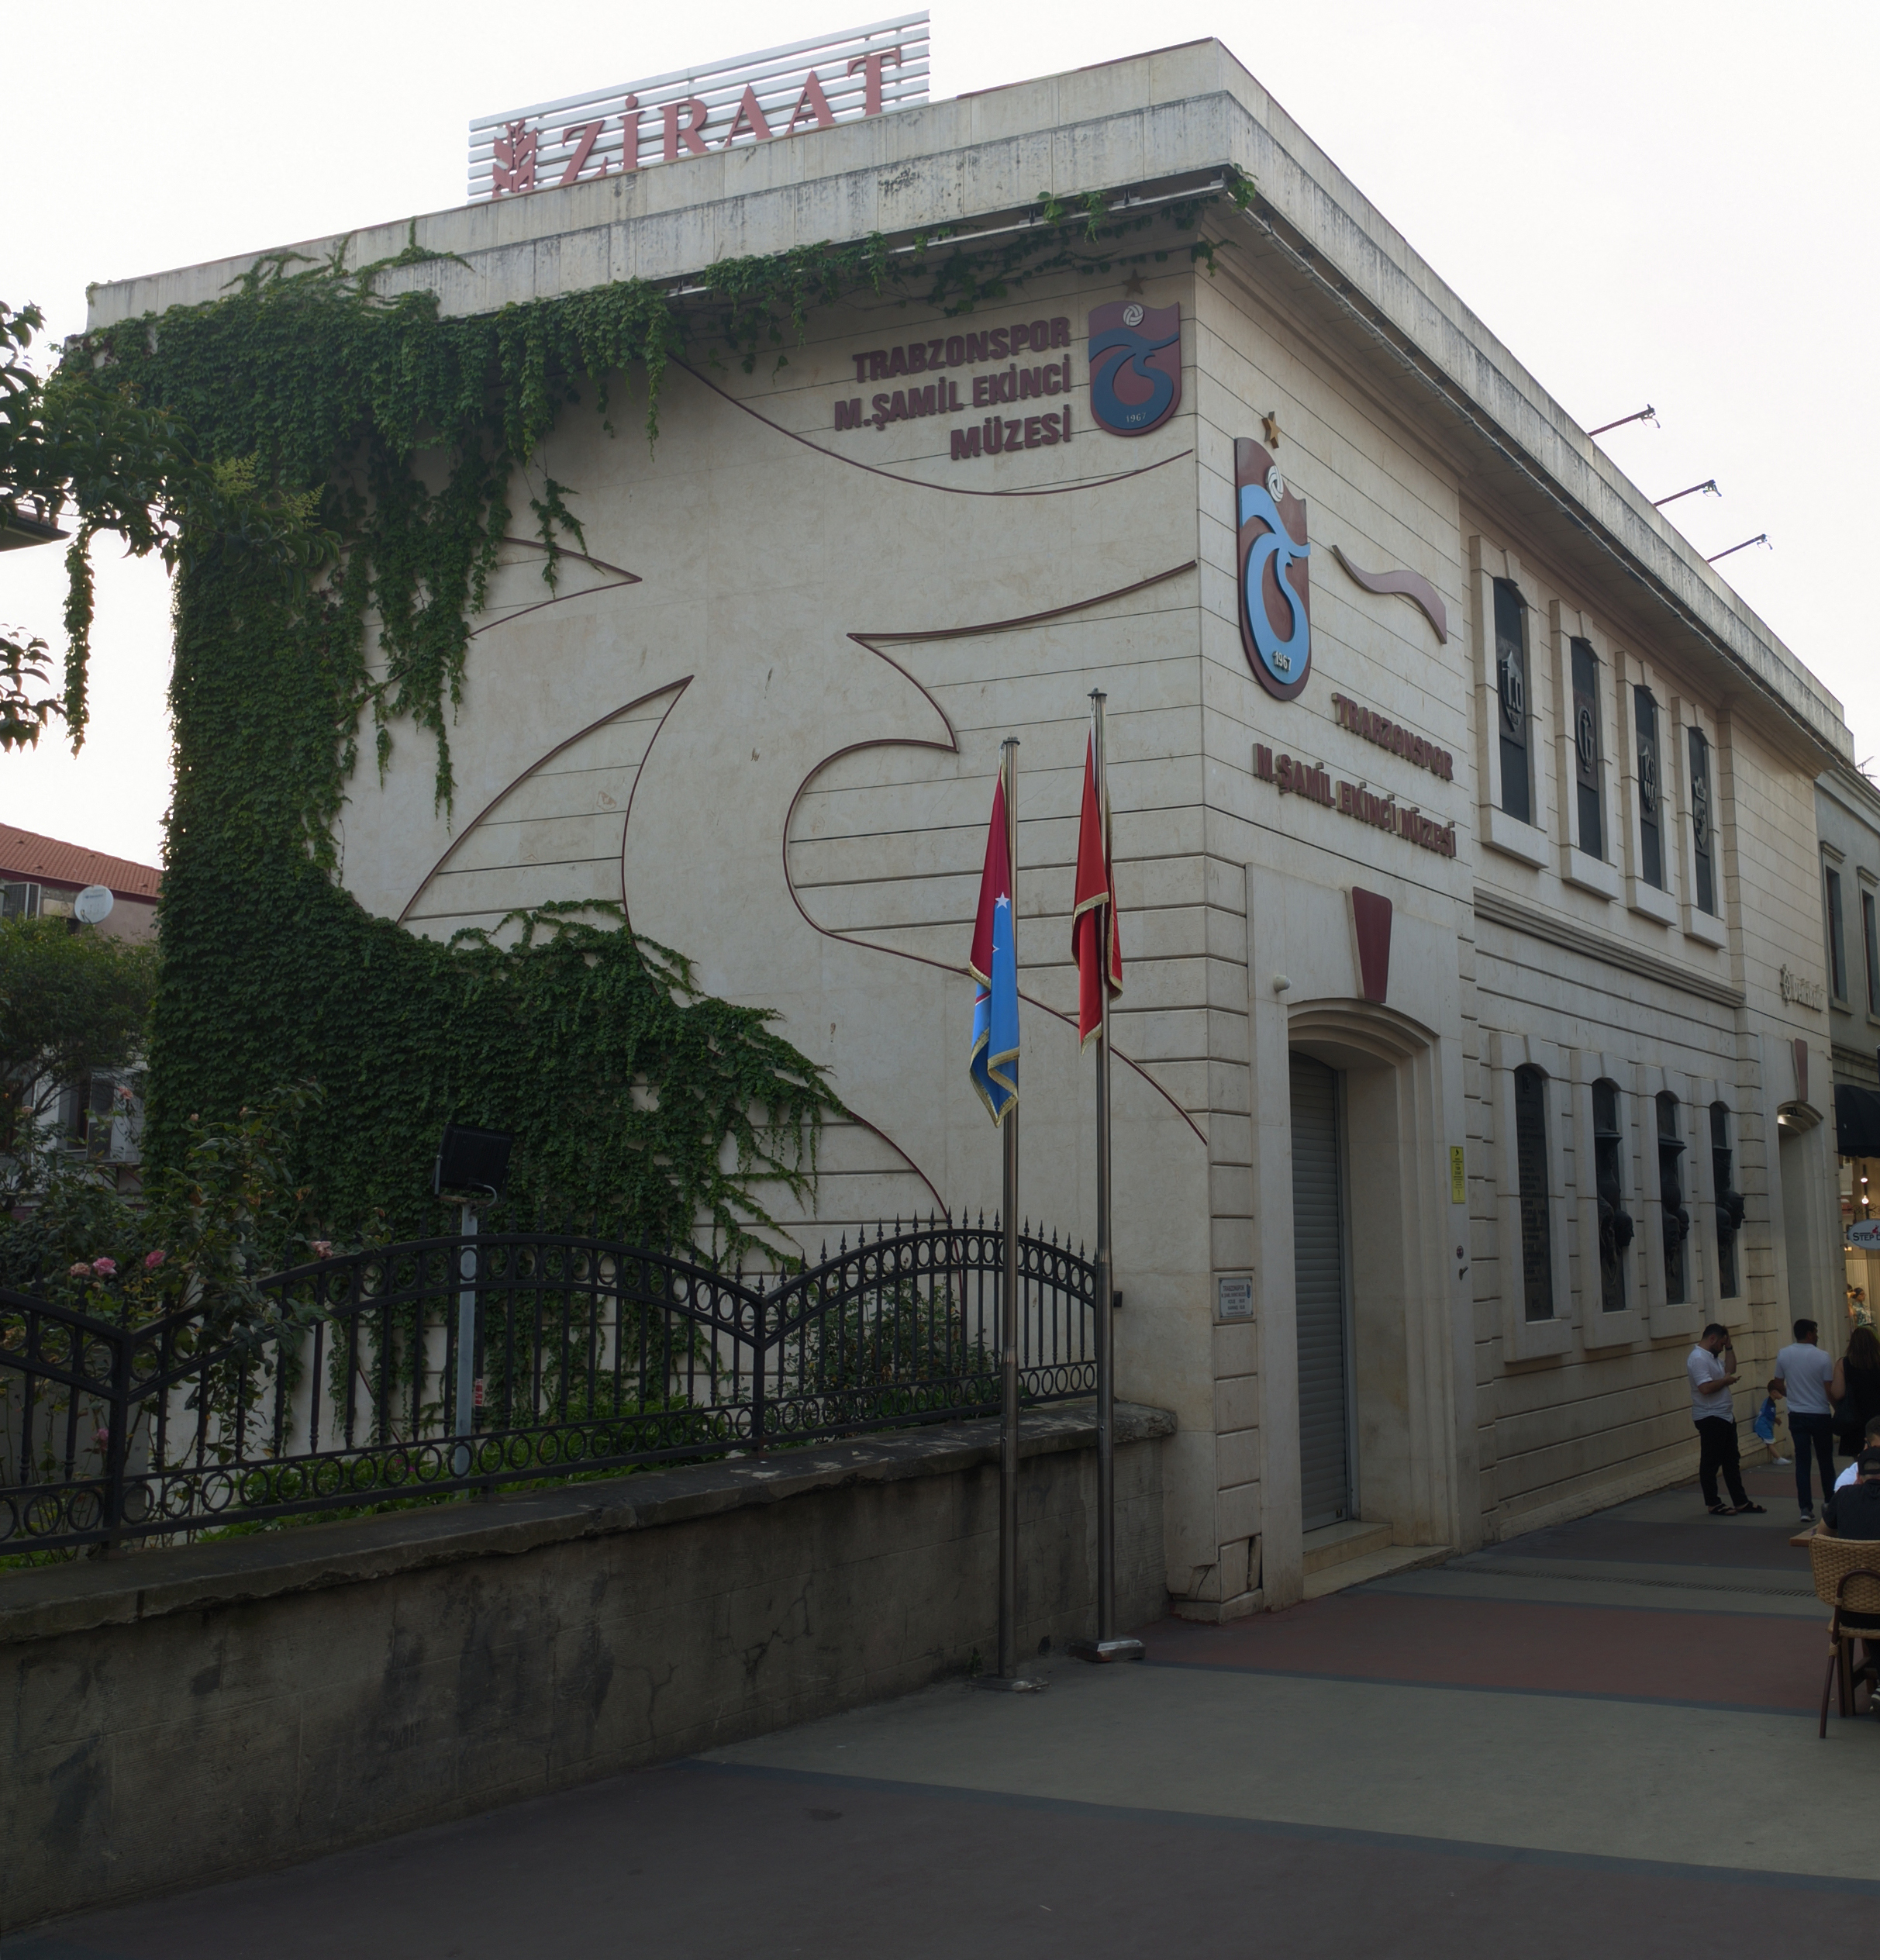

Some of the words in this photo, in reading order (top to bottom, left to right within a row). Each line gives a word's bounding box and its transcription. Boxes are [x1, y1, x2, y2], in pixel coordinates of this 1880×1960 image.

[562, 48, 902, 185] ZİRAAT
[853, 316, 1071, 384] TRABZONSPOR
[834, 376, 964, 431] M.ŞAMİL
[973, 354, 1071, 408] EKİNCİ
[1126, 412, 1147, 423] 1967
[950, 404, 1071, 461] MÜZESİ
[1272, 650, 1292, 672] 1967
[1331, 692, 1454, 780] TRABZONSPOR
[1253, 743, 1336, 807] M.ŞAMİL
[1336, 781, 1397, 832] EKİNCİ
[1397, 806, 1457, 858] MÜZESİ
[1853, 1232, 1875, 1241] STEP
